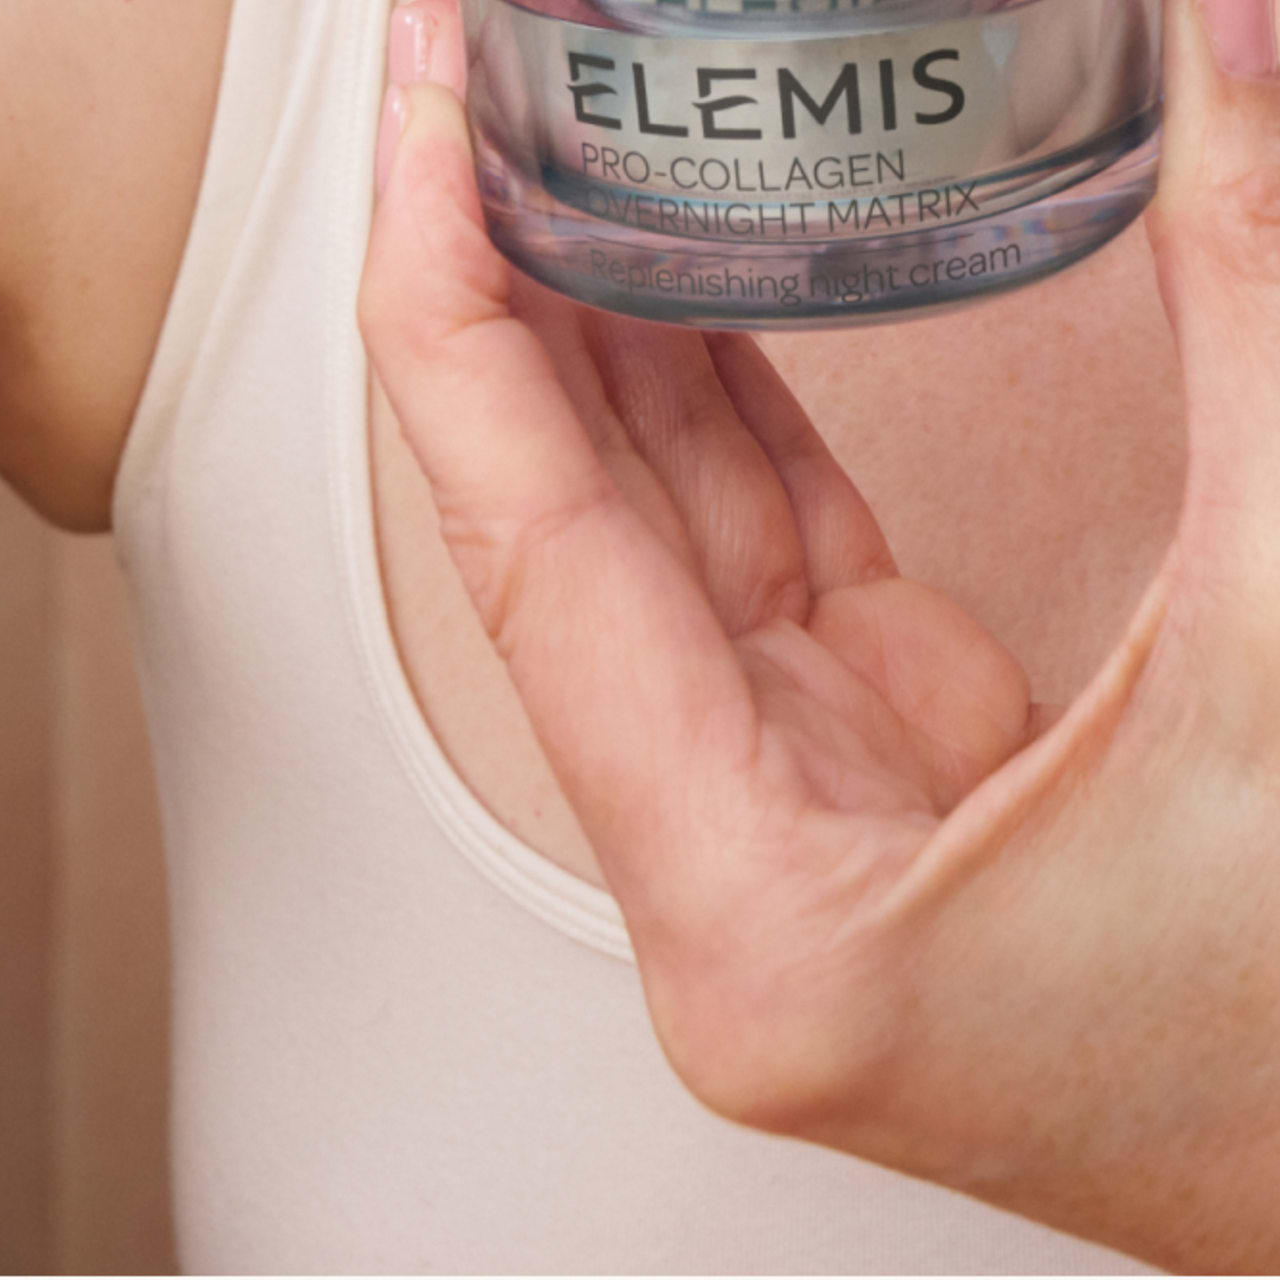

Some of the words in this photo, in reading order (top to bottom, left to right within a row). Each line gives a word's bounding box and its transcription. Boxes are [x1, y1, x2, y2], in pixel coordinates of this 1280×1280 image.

[566, 48, 967, 141] ELEMIS
[581, 142, 906, 192] PRO-COLLAGEN
[587, 187, 816, 235] OVERNIGHT
[828, 181, 981, 233] MATRIX
[590, 248, 802, 307] Replenishing
[809, 263, 903, 304] night
[909, 243, 1021, 287] cream
